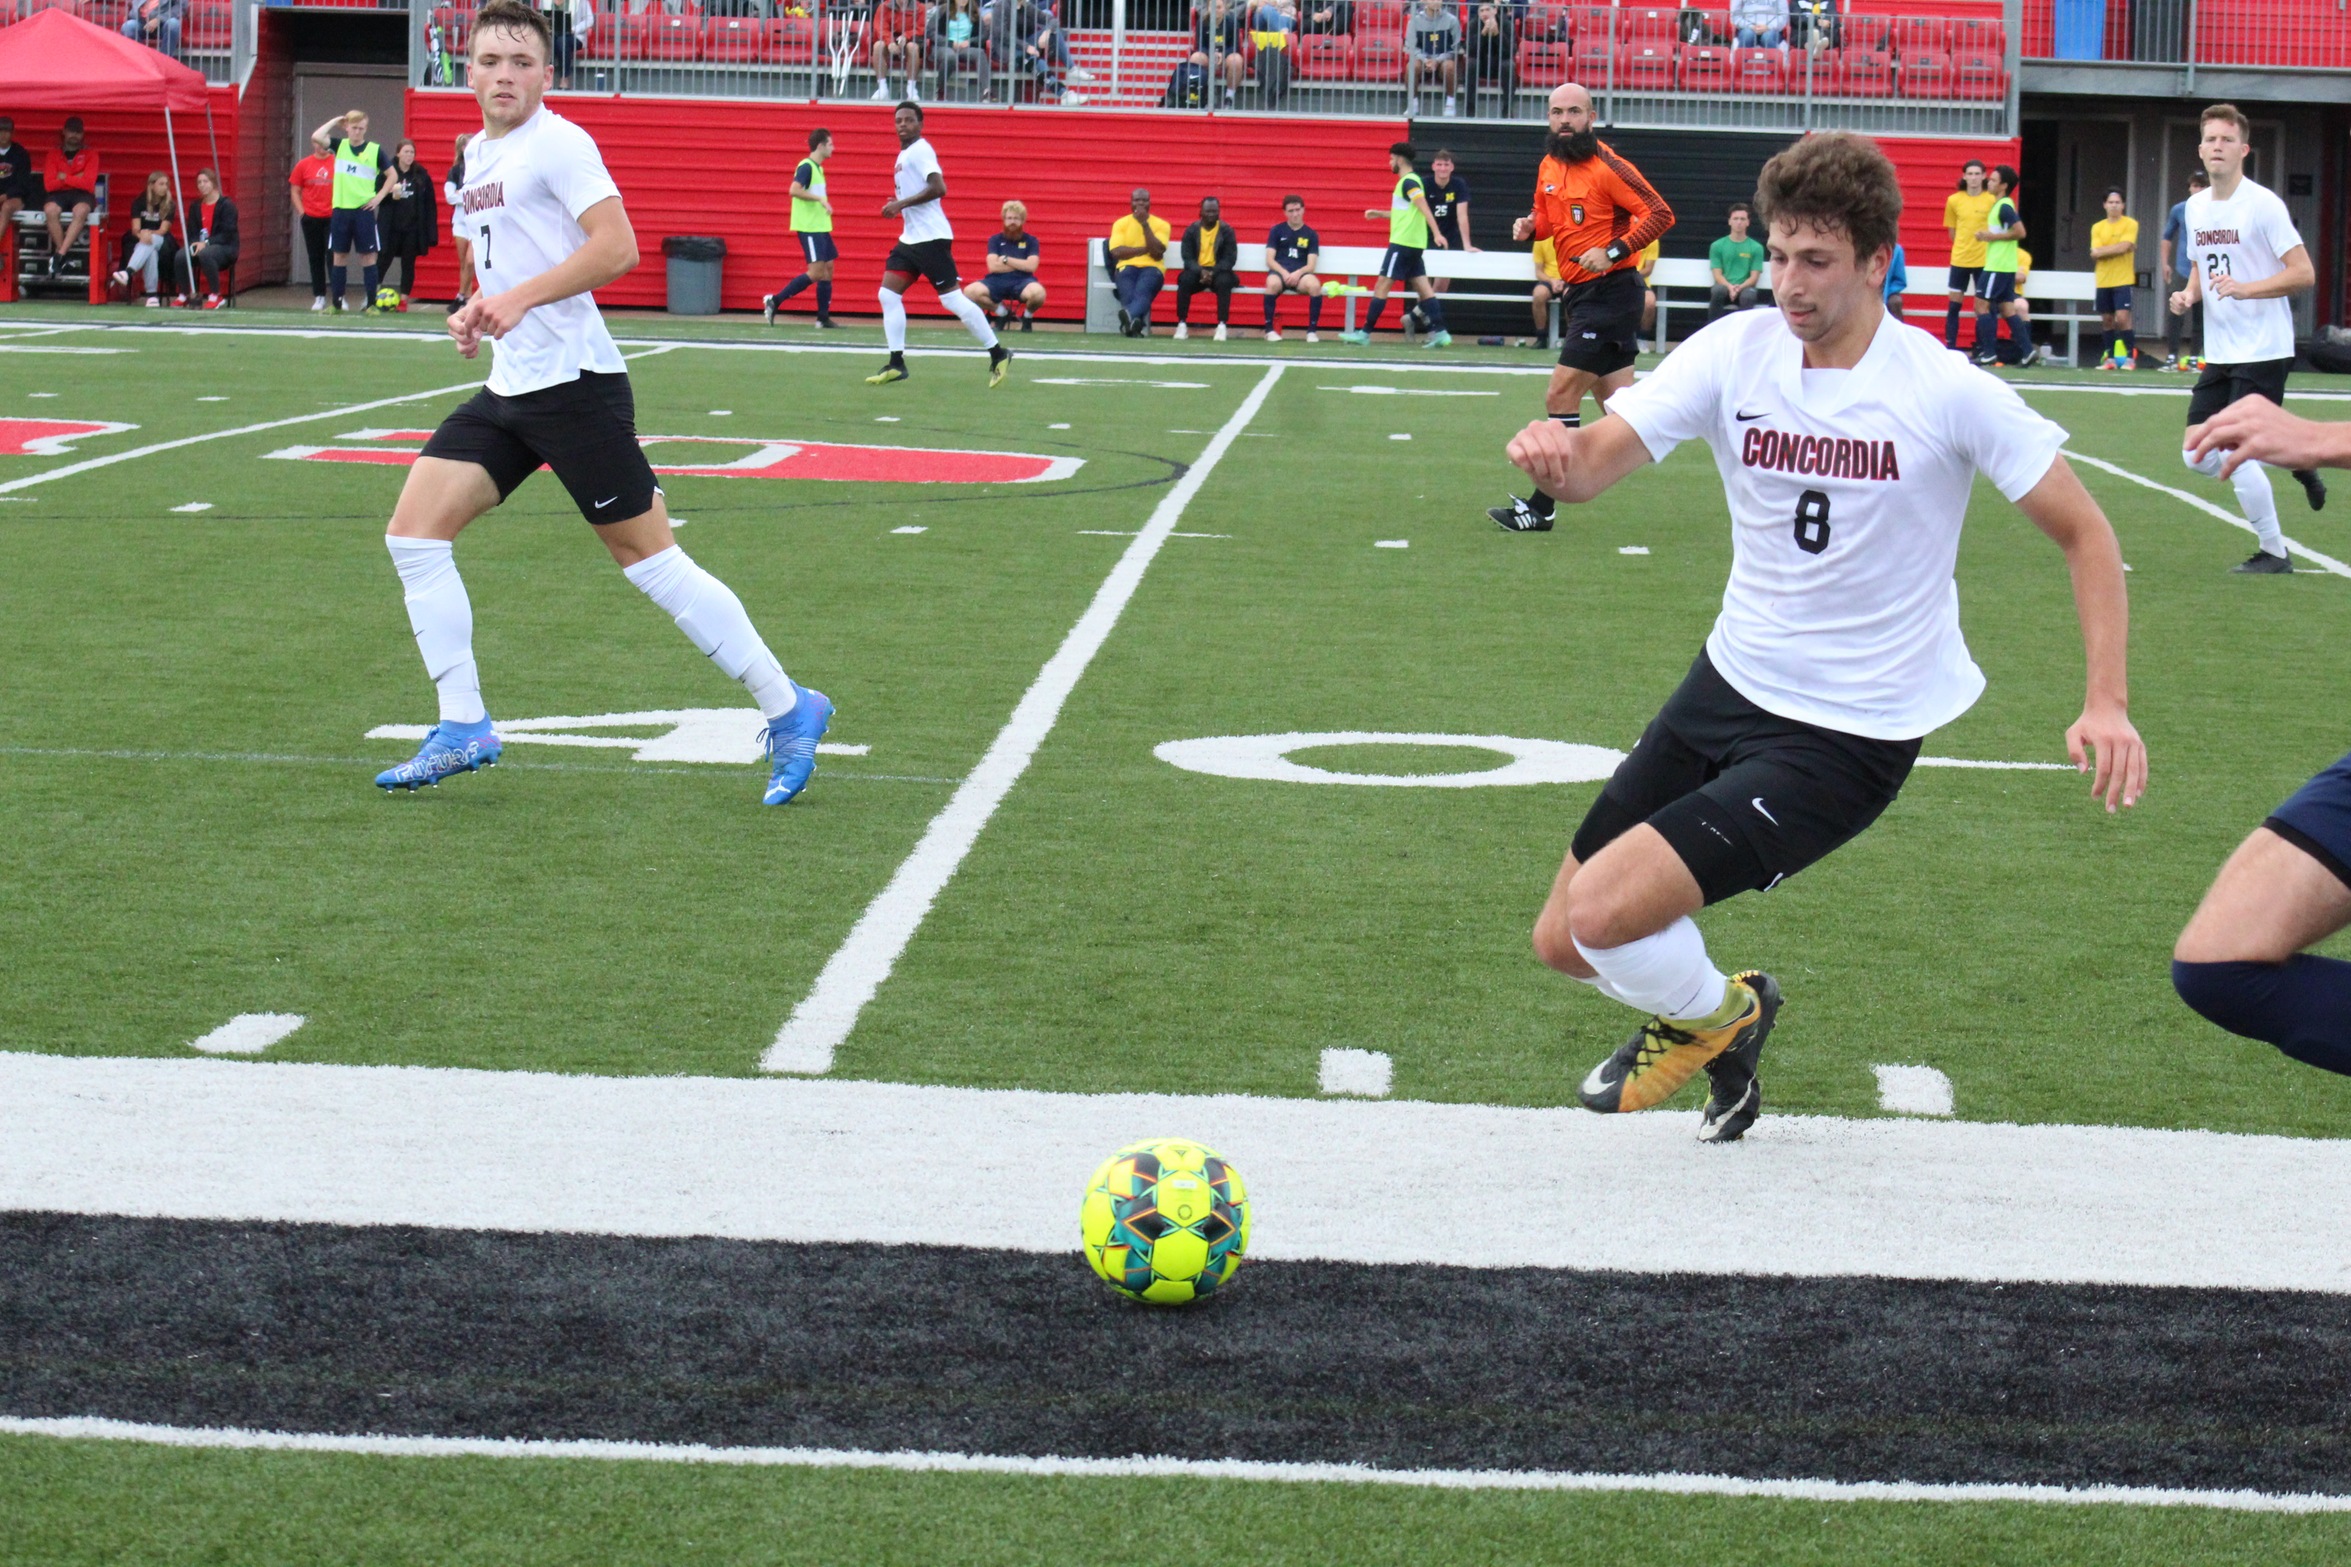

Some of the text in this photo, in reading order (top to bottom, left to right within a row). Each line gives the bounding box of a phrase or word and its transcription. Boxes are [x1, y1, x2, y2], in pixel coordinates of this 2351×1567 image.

[1434, 204, 1448, 217] 25
[480, 224, 492, 269] 7
[2195, 229, 2240, 247] CONCORDIA
[1741, 427, 1900, 481] CONCORDIA
[1794, 489, 1831, 555] 8
